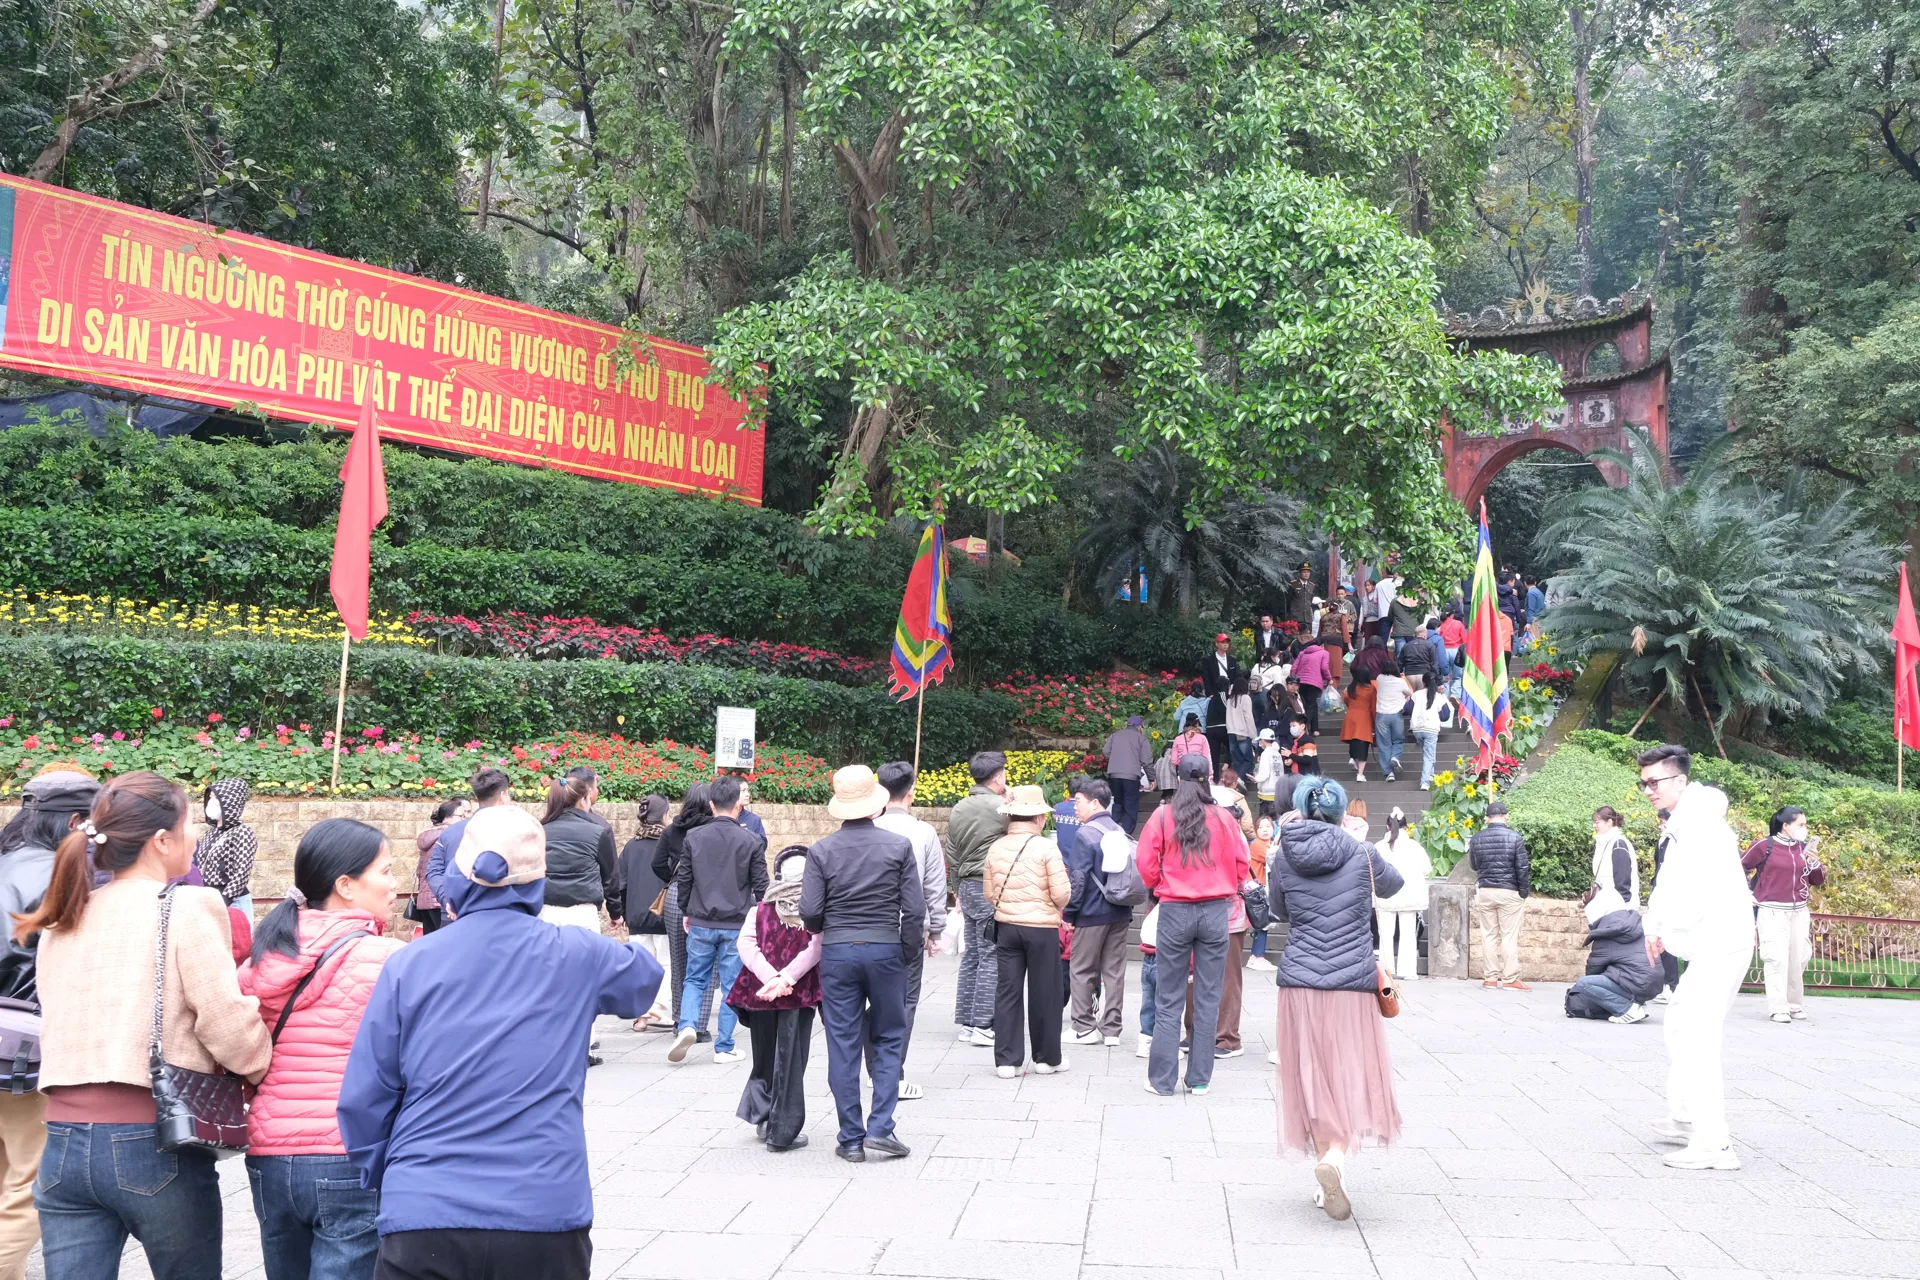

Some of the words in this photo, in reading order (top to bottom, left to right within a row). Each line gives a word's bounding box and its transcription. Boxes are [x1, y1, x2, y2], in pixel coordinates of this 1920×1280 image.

[37, 298, 72, 348] DI
[82, 294, 151, 364] SẢN
[161, 319, 221, 378] VĂN
[229, 336, 287, 391] HÓA
[296, 352, 344, 402] PHI
[408, 367, 456, 423] THỂ
[461, 387, 502, 440] ĐẠI
[509, 396, 565, 450] DIỆN
[571, 398, 616, 457] CỦA
[623, 421, 685, 471] NHÂN
[691, 436, 736, 486] LOẠI
[102, 229, 153, 288] TÍN
[162, 249, 285, 319] NGƯỠNG
[294, 278, 349, 331] THỜ
[355, 292, 426, 349] CÚNG
[434, 311, 502, 367] HÙNG
[509, 331, 587, 386] VƯƠNG
[594, 337, 609, 391] Ở
[666, 369, 705, 420] THỌ
